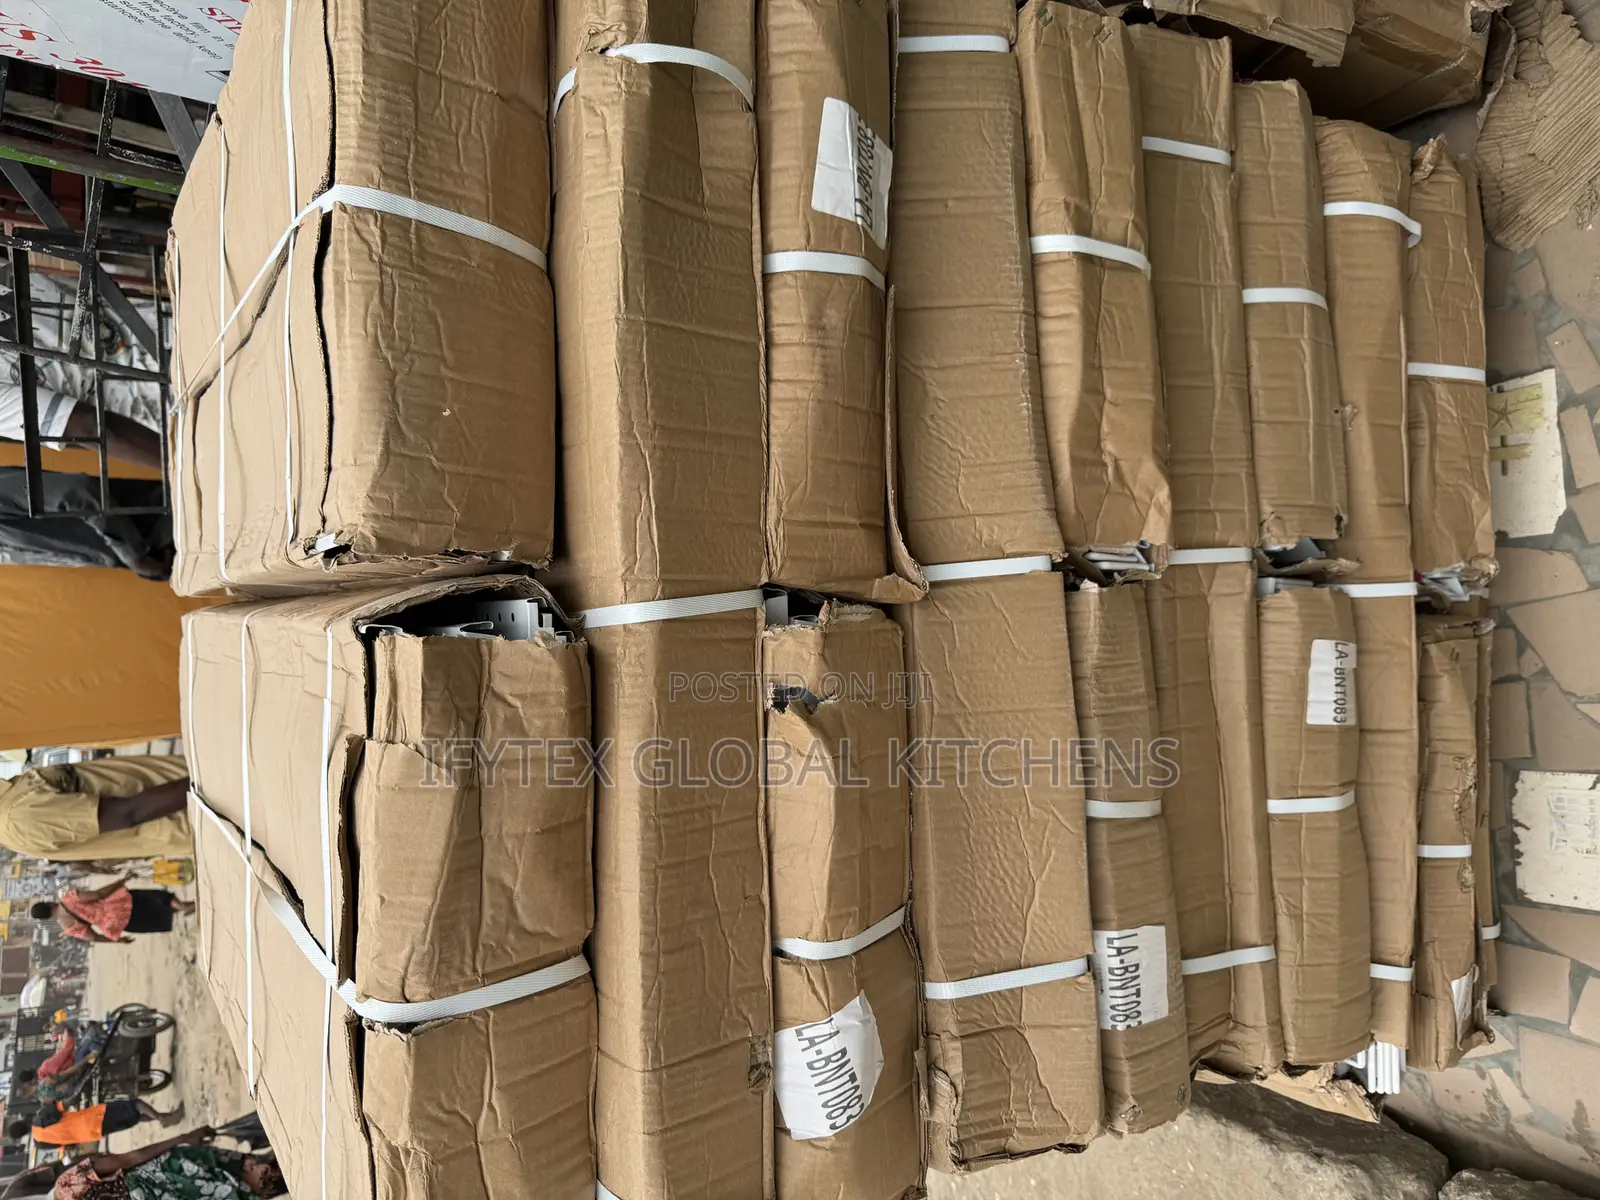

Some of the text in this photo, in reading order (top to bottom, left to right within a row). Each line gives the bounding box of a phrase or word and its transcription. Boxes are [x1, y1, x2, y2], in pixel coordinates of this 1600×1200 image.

[173, 31, 198, 44] and
[1333, 642, 1349, 724] LA-BNT083
[794, 1016, 865, 1131] LA-BNT083
